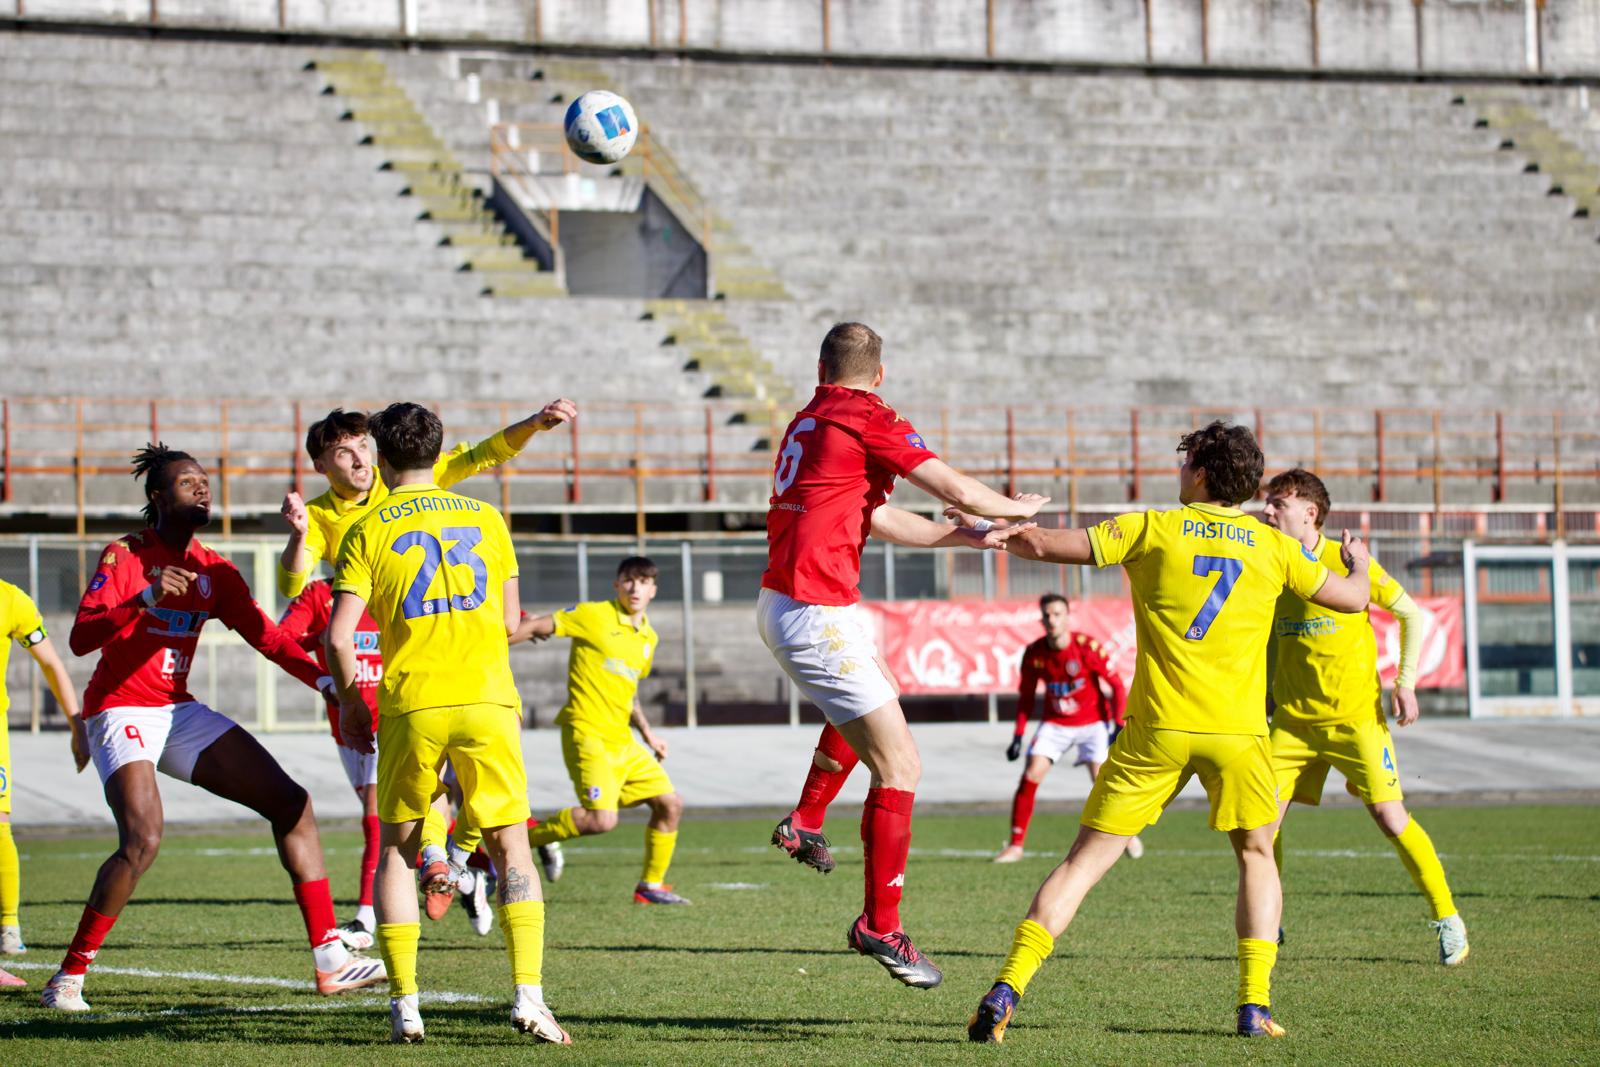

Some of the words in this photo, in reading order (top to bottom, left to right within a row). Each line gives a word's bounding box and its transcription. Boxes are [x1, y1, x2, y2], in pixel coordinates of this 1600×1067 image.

[774, 417, 816, 496] 6
[379, 496, 481, 523] COSTANTINO
[1183, 519, 1255, 547] PASTORE
[391, 526, 488, 620] 23
[1184, 554, 1243, 641] 7
[124, 724, 144, 748] 9
[1382, 746, 1394, 775] 4
